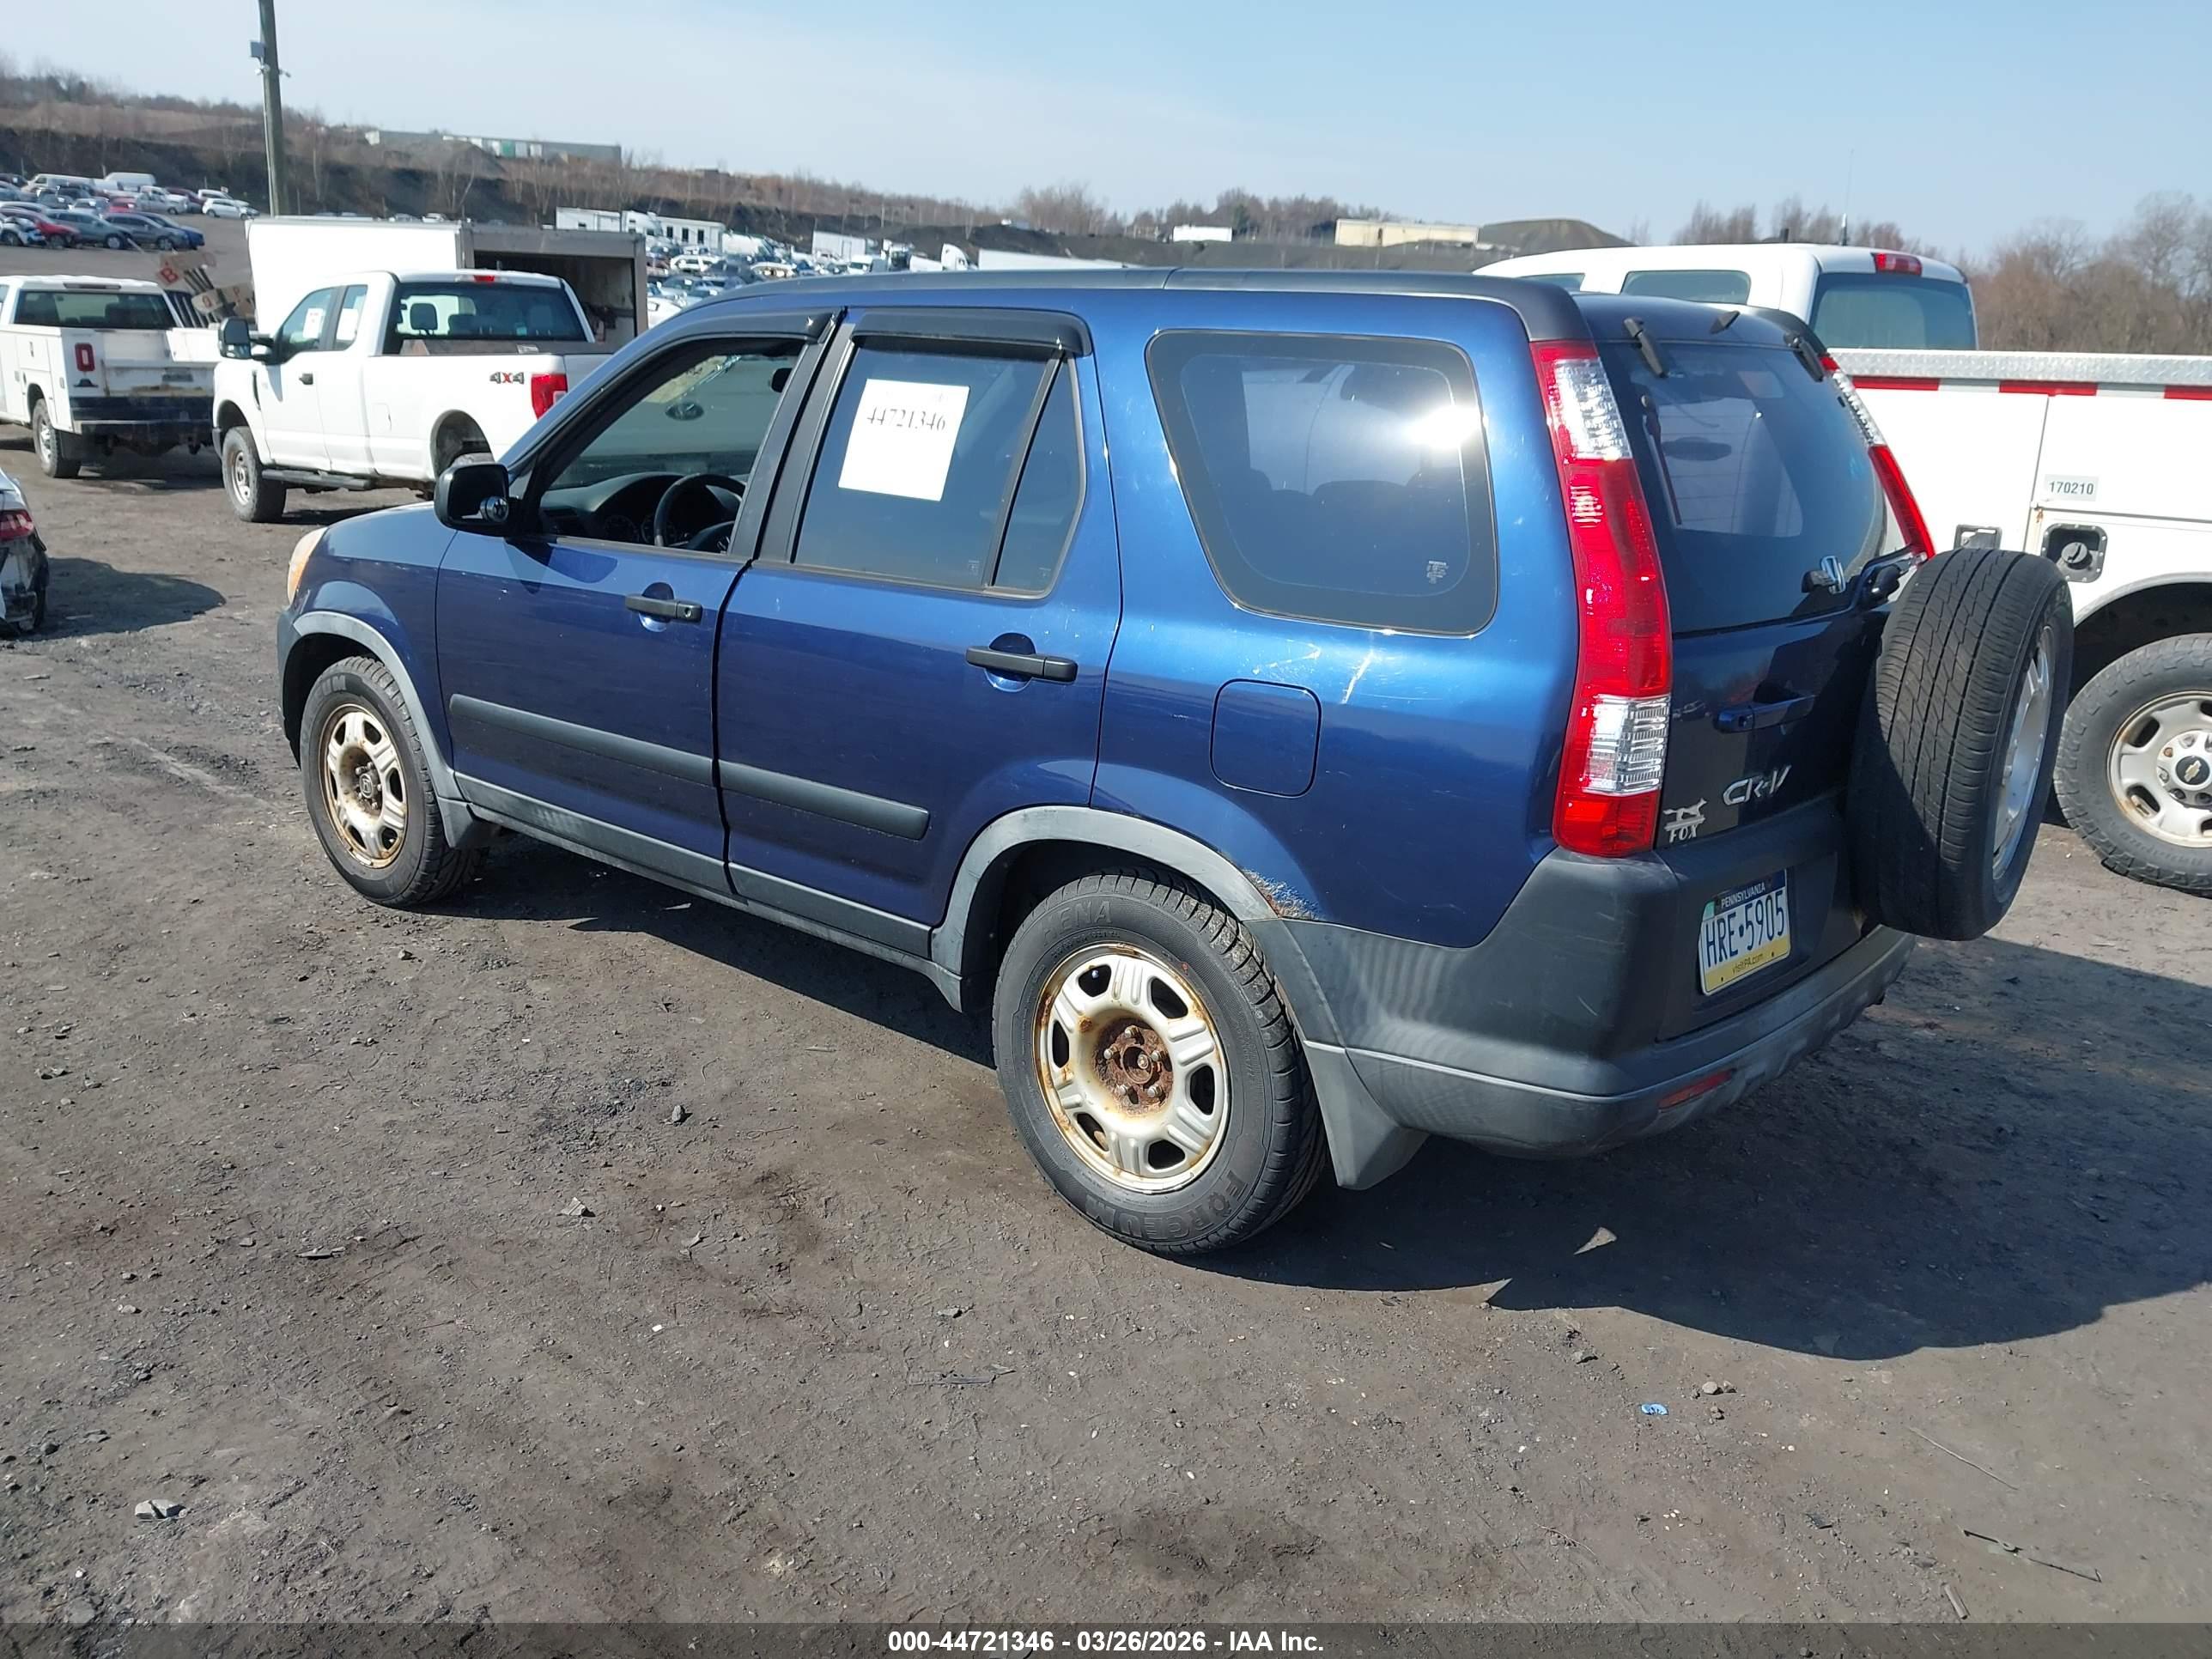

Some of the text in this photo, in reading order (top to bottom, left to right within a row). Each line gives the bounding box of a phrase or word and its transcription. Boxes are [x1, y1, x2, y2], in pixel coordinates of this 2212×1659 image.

[866, 406, 946, 433] 44721346
[2050, 481, 2094, 495] 170210
[1723, 765, 1791, 805] CR-V
[1669, 824, 1698, 843] FOX
[1720, 883, 1766, 908] PENNSYLVANIA
[1085, 1170, 1249, 1239] FORCEUM
